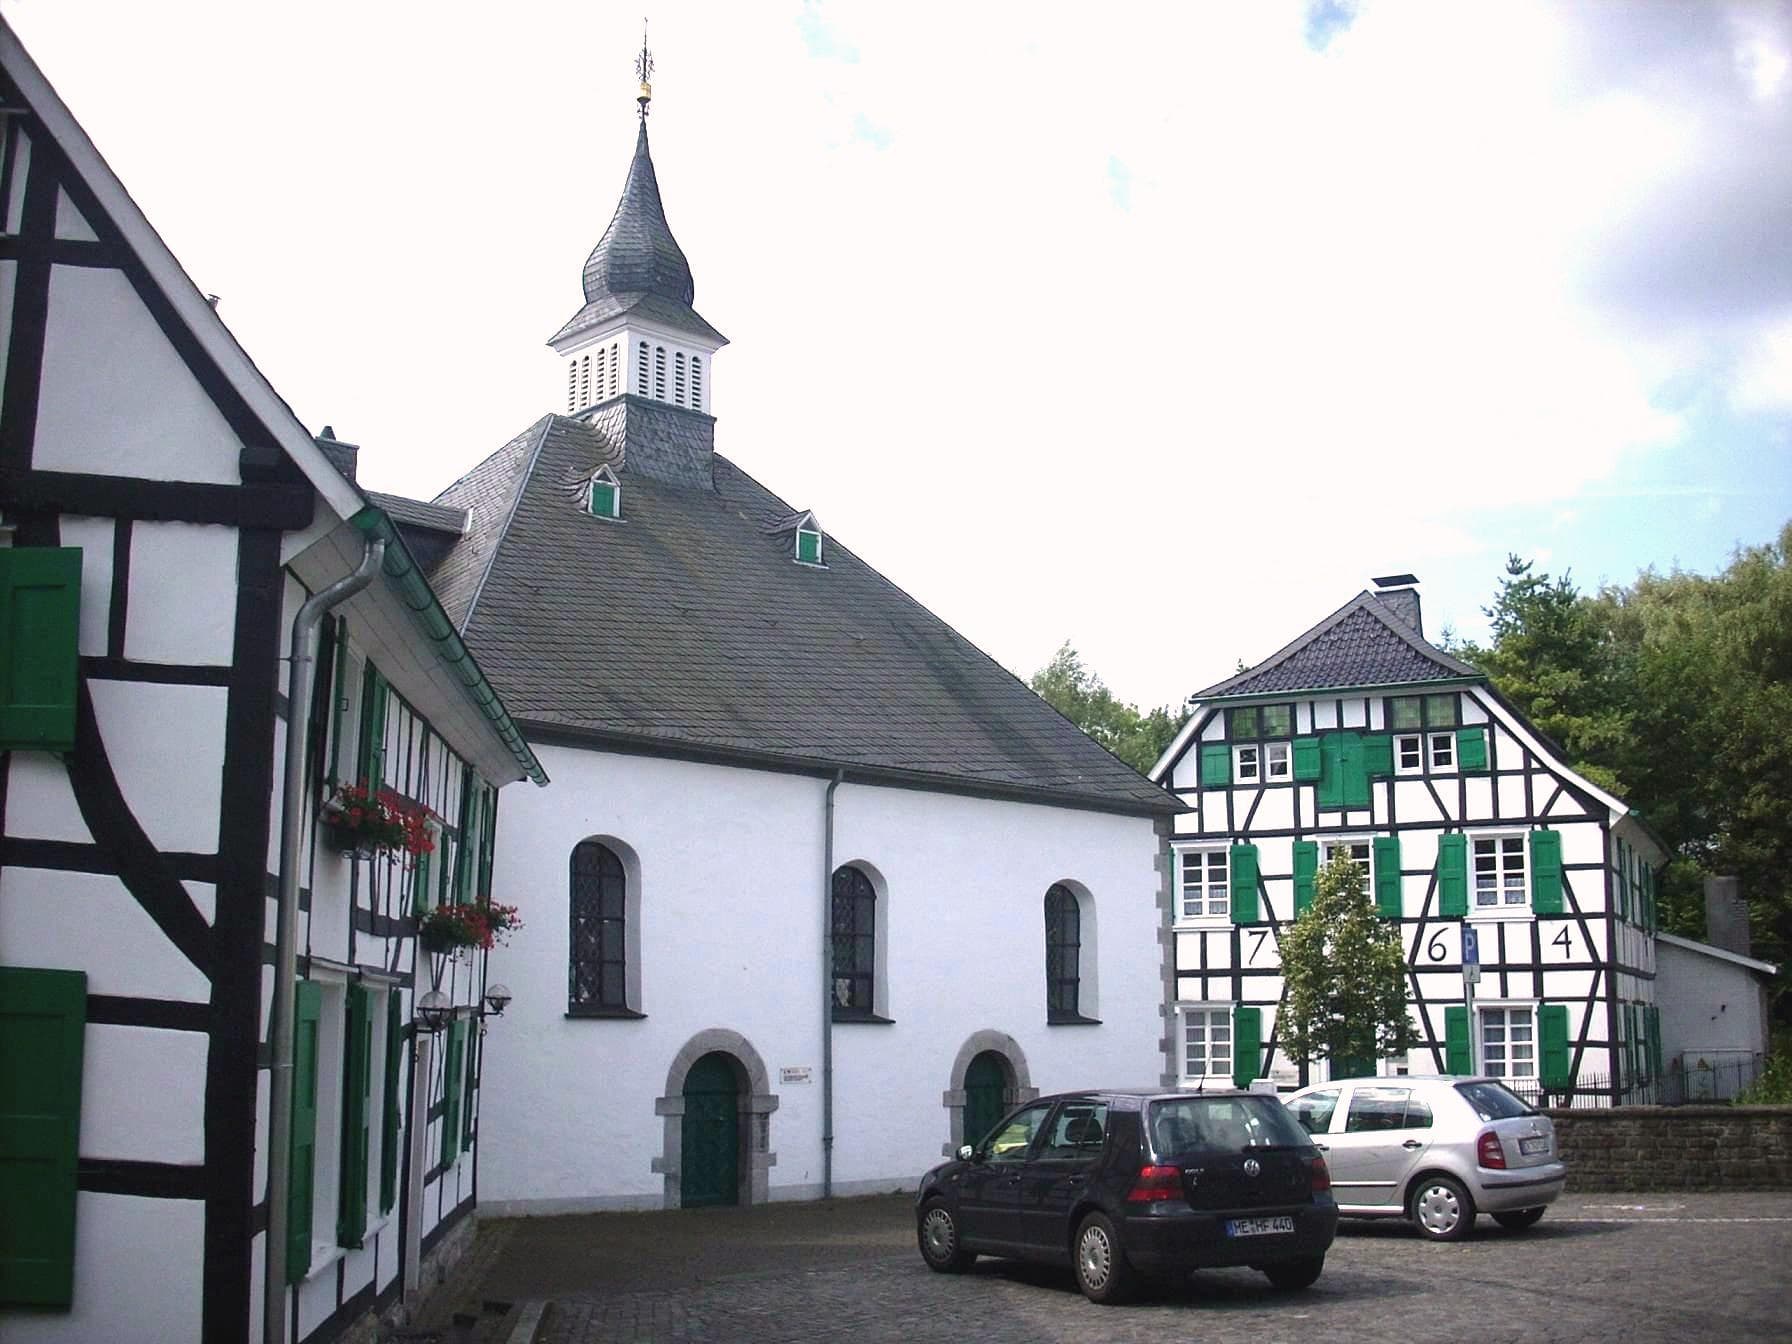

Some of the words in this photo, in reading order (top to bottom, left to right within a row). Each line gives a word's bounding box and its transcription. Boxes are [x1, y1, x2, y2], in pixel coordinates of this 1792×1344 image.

[1248, 930, 1269, 965] 7
[1427, 927, 1449, 962] 6
[1551, 924, 1572, 960] 4
[1464, 932, 1475, 960] P
